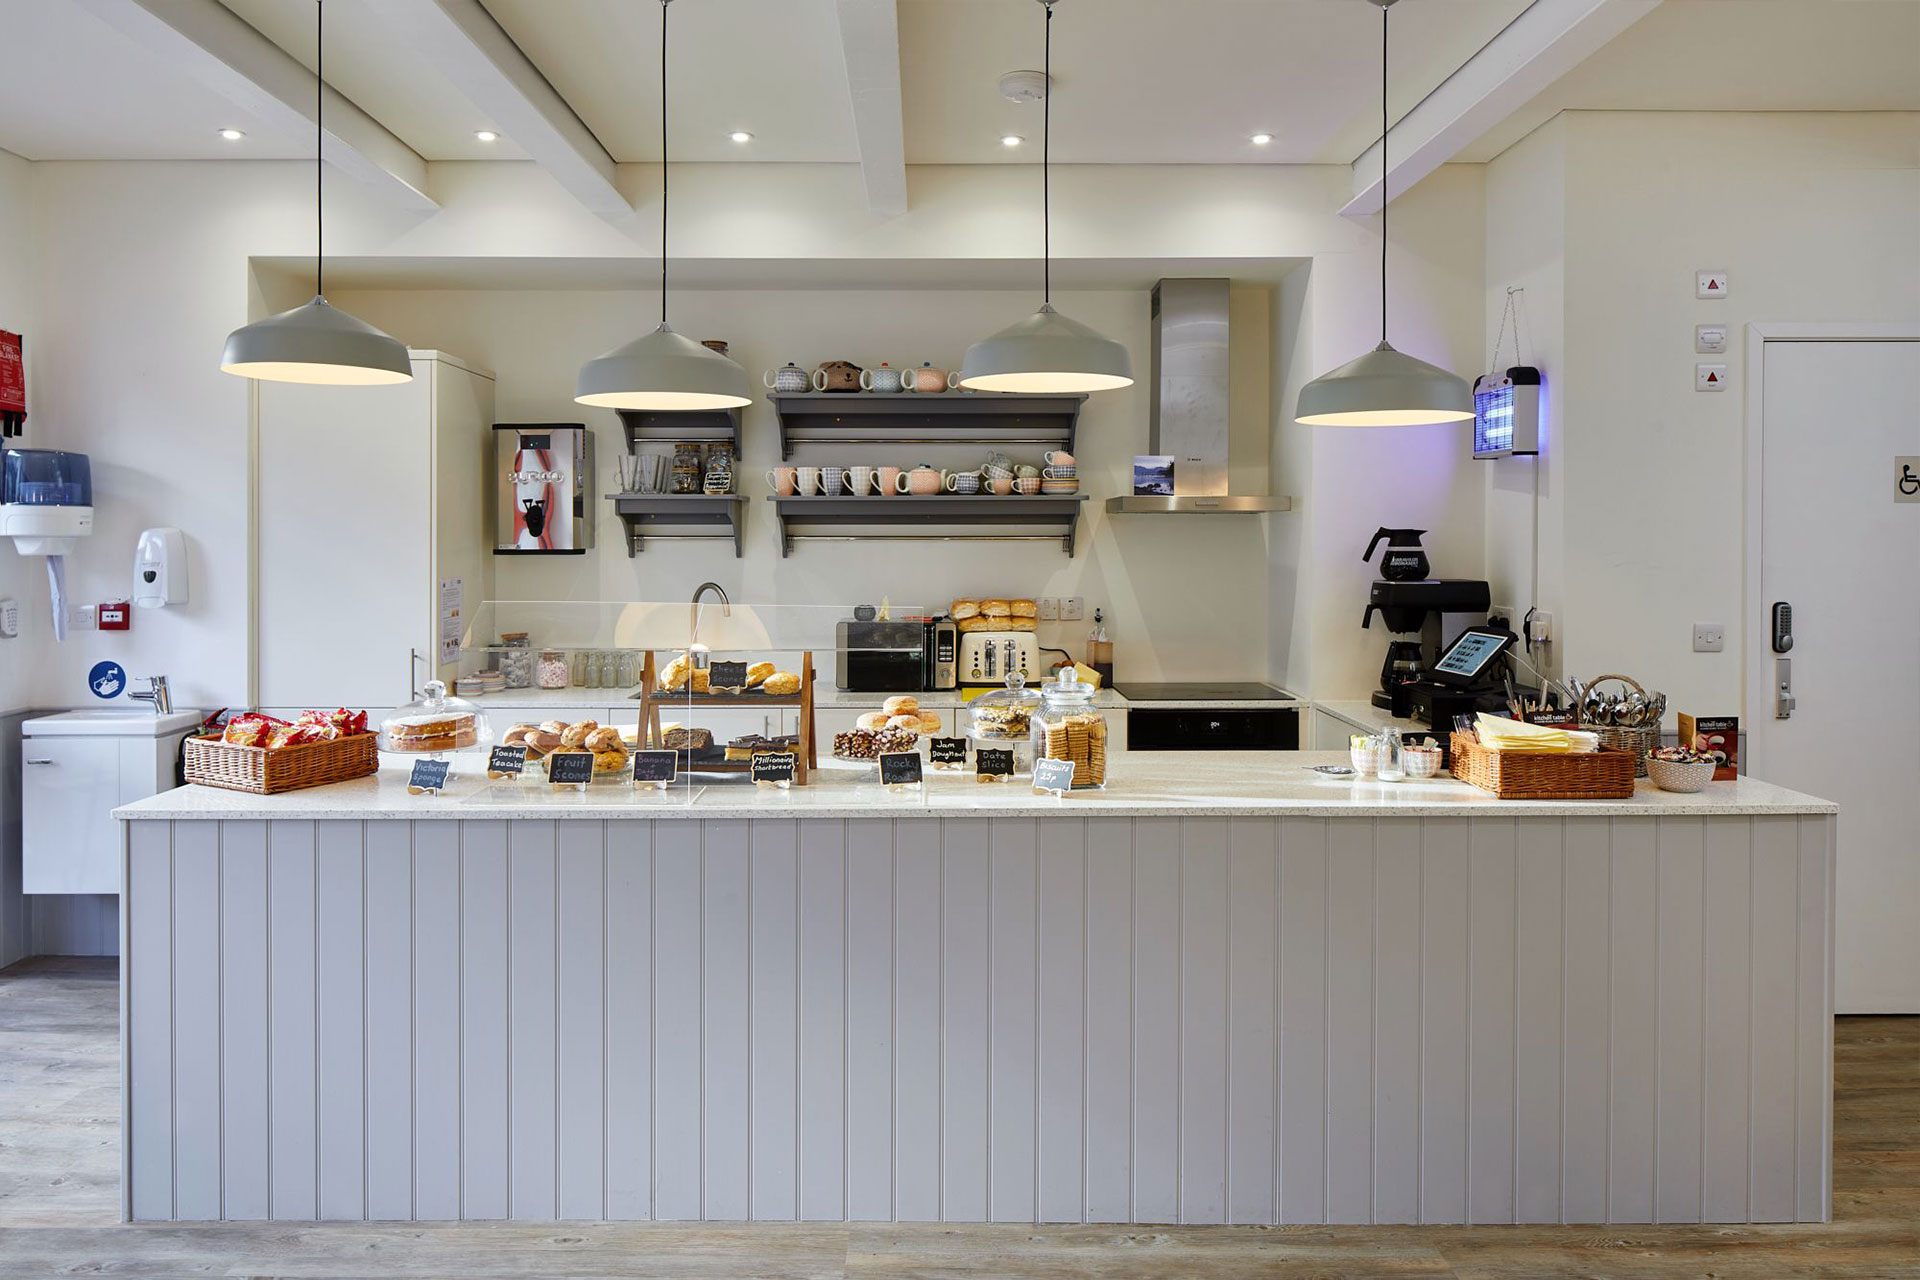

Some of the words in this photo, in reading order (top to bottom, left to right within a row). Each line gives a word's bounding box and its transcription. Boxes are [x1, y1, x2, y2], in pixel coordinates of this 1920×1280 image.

[936, 740, 956, 749] Jam
[494, 748, 525, 759] Toasted
[983, 752, 1006, 760] Date
[415, 763, 446, 772] Victoria
[492, 759, 522, 769] Teacake
[557, 756, 586, 769] Fruit
[886, 758, 918, 769] Rocky
[1040, 761, 1070, 773] Biscuits
[554, 769, 590, 780] Scones
[884, 772, 911, 781] Road
